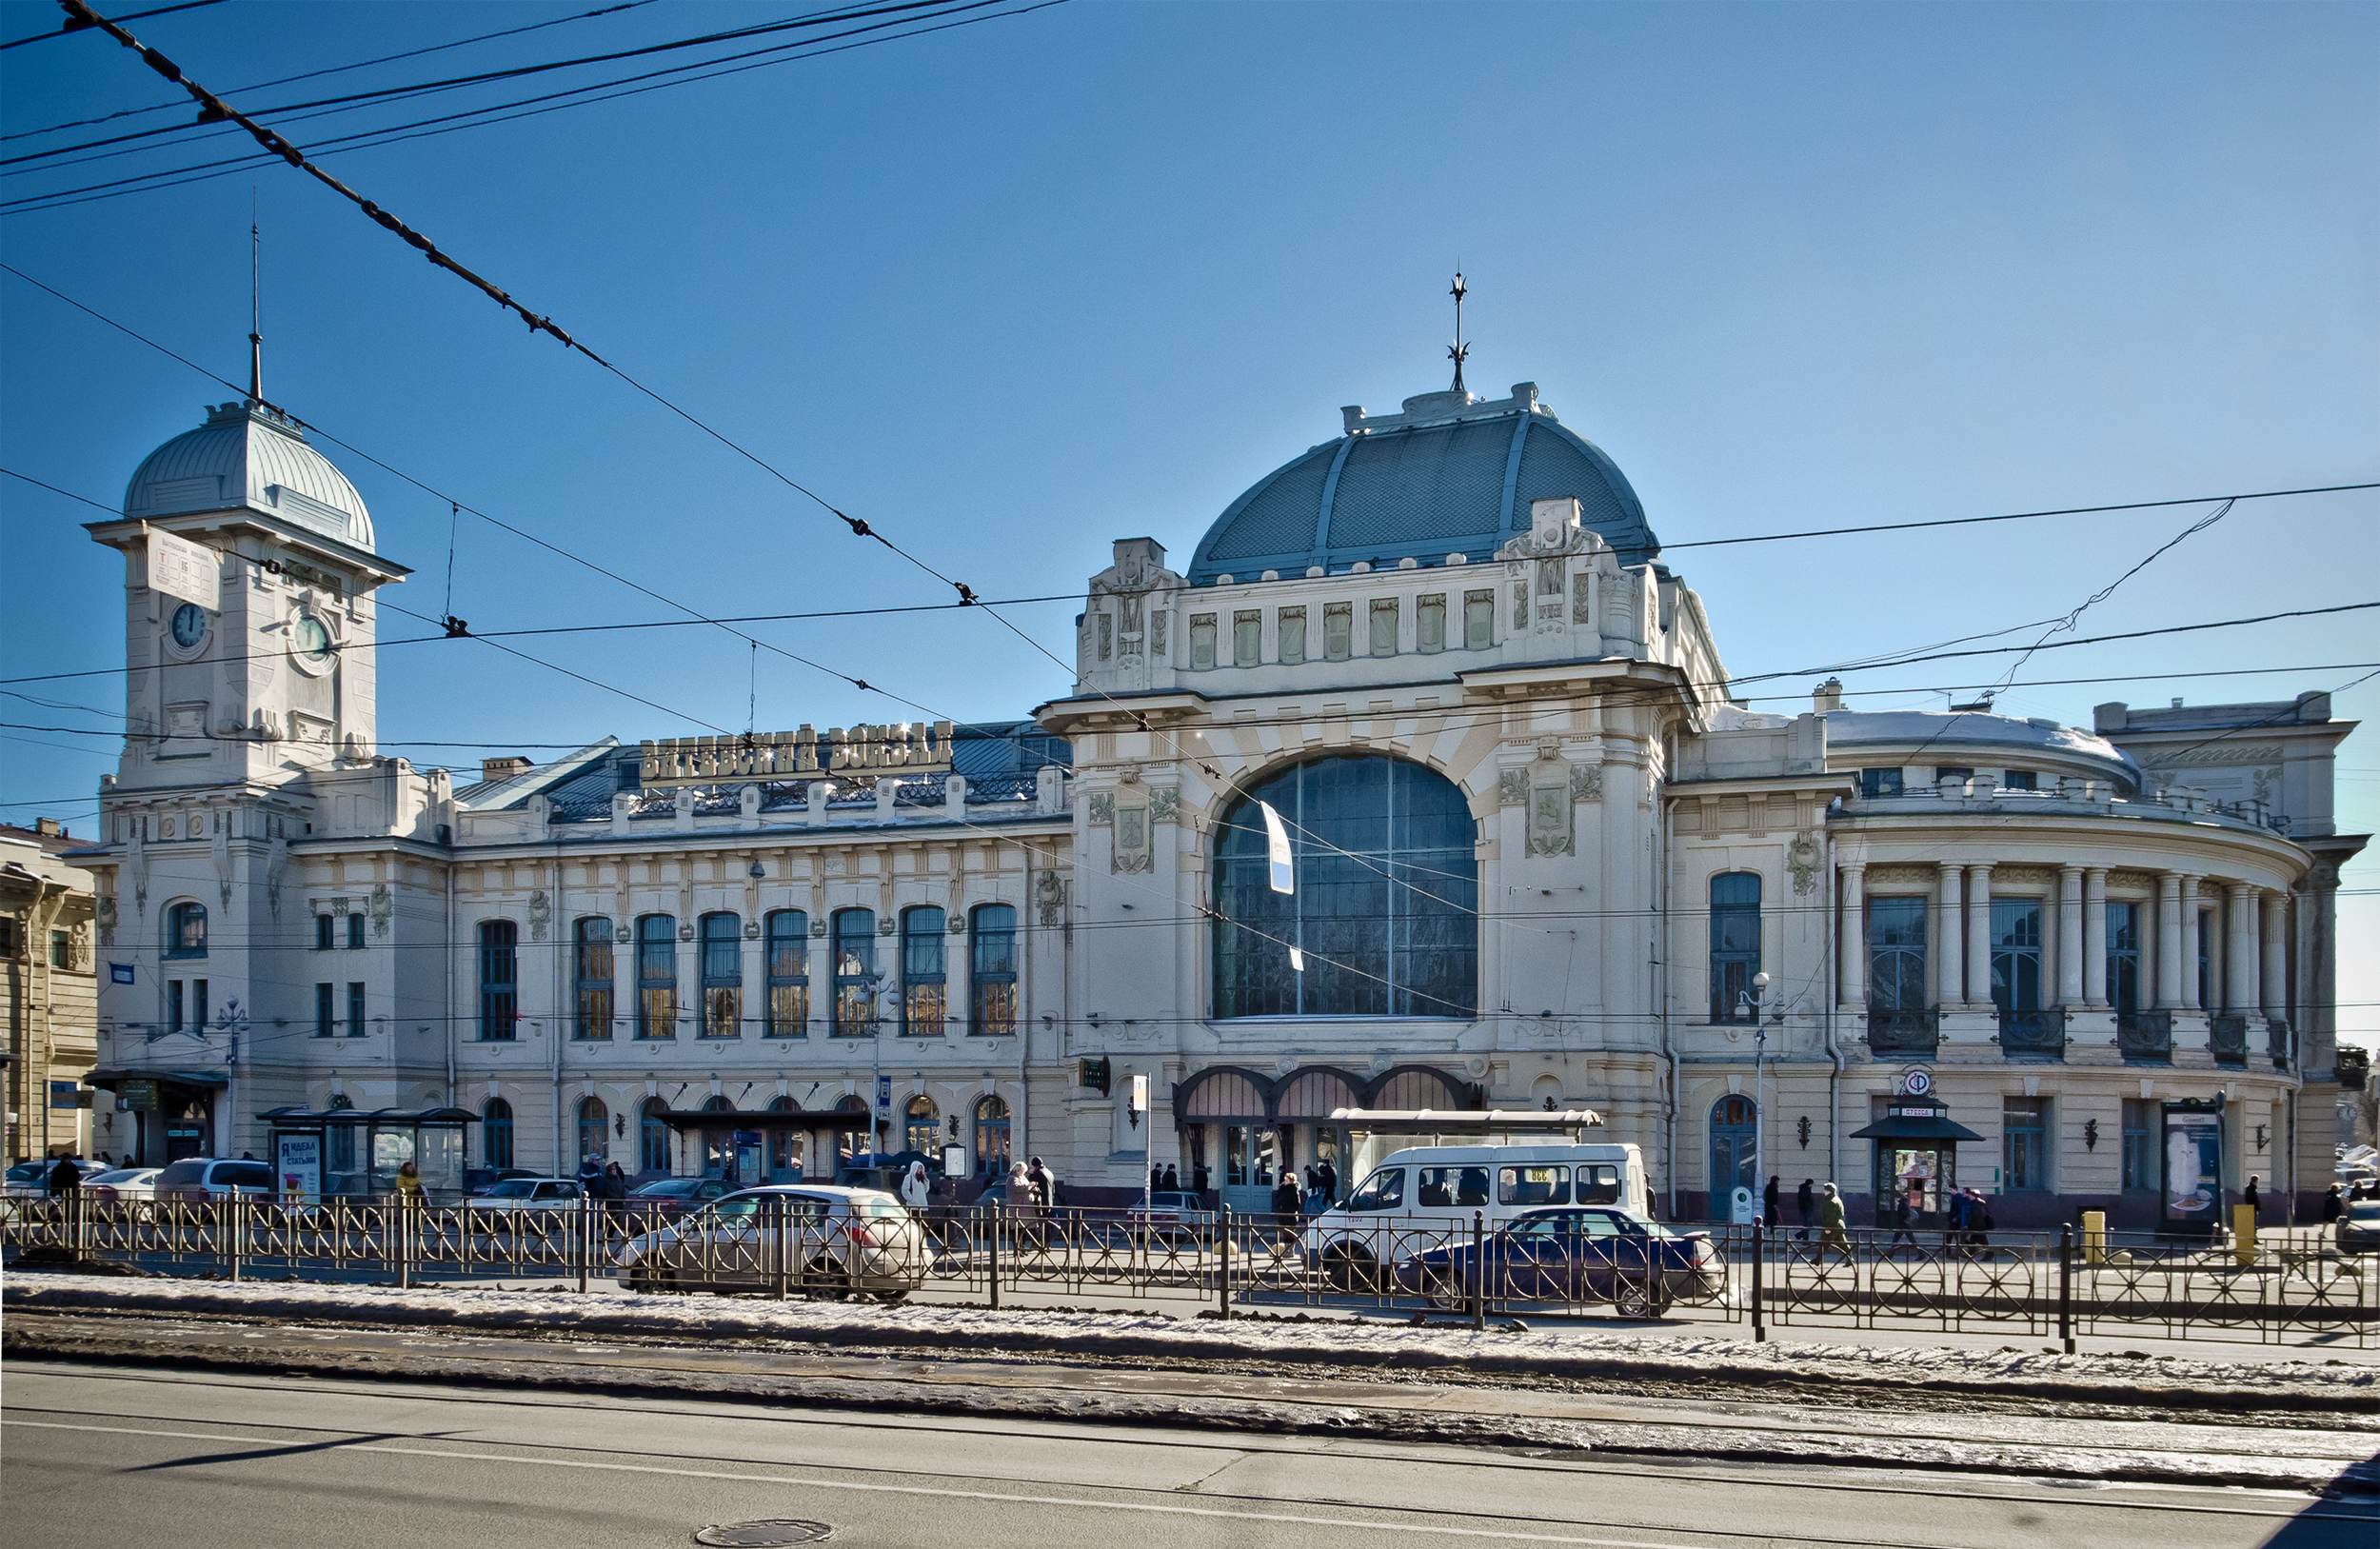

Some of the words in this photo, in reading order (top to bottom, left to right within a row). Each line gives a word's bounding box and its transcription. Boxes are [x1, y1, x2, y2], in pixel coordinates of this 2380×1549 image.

[641, 724, 818, 779] ВИТЕБСКИЙ
[829, 721, 953, 769] ВОКЗАЛ
[282, 1142, 289, 1157] Я
